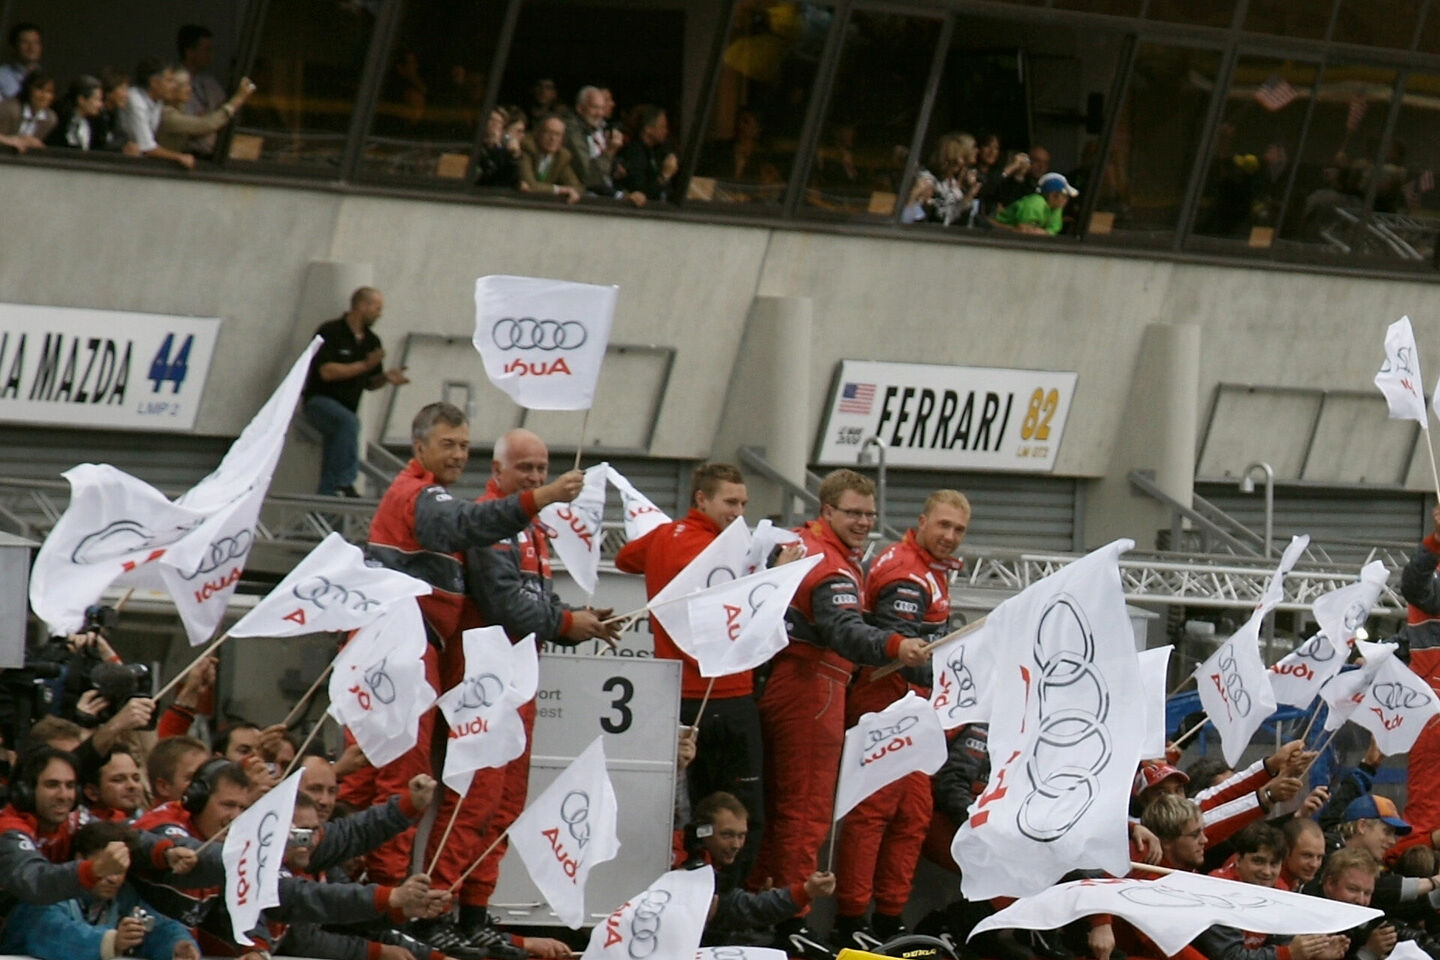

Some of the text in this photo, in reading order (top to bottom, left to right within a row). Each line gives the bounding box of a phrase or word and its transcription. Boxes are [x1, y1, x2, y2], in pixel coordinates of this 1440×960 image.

[29, 333, 133, 404] MAZDA
[148, 333, 194, 394] 44
[875, 386, 1059, 451] FERRARI 82
[600, 676, 634, 734] 3
